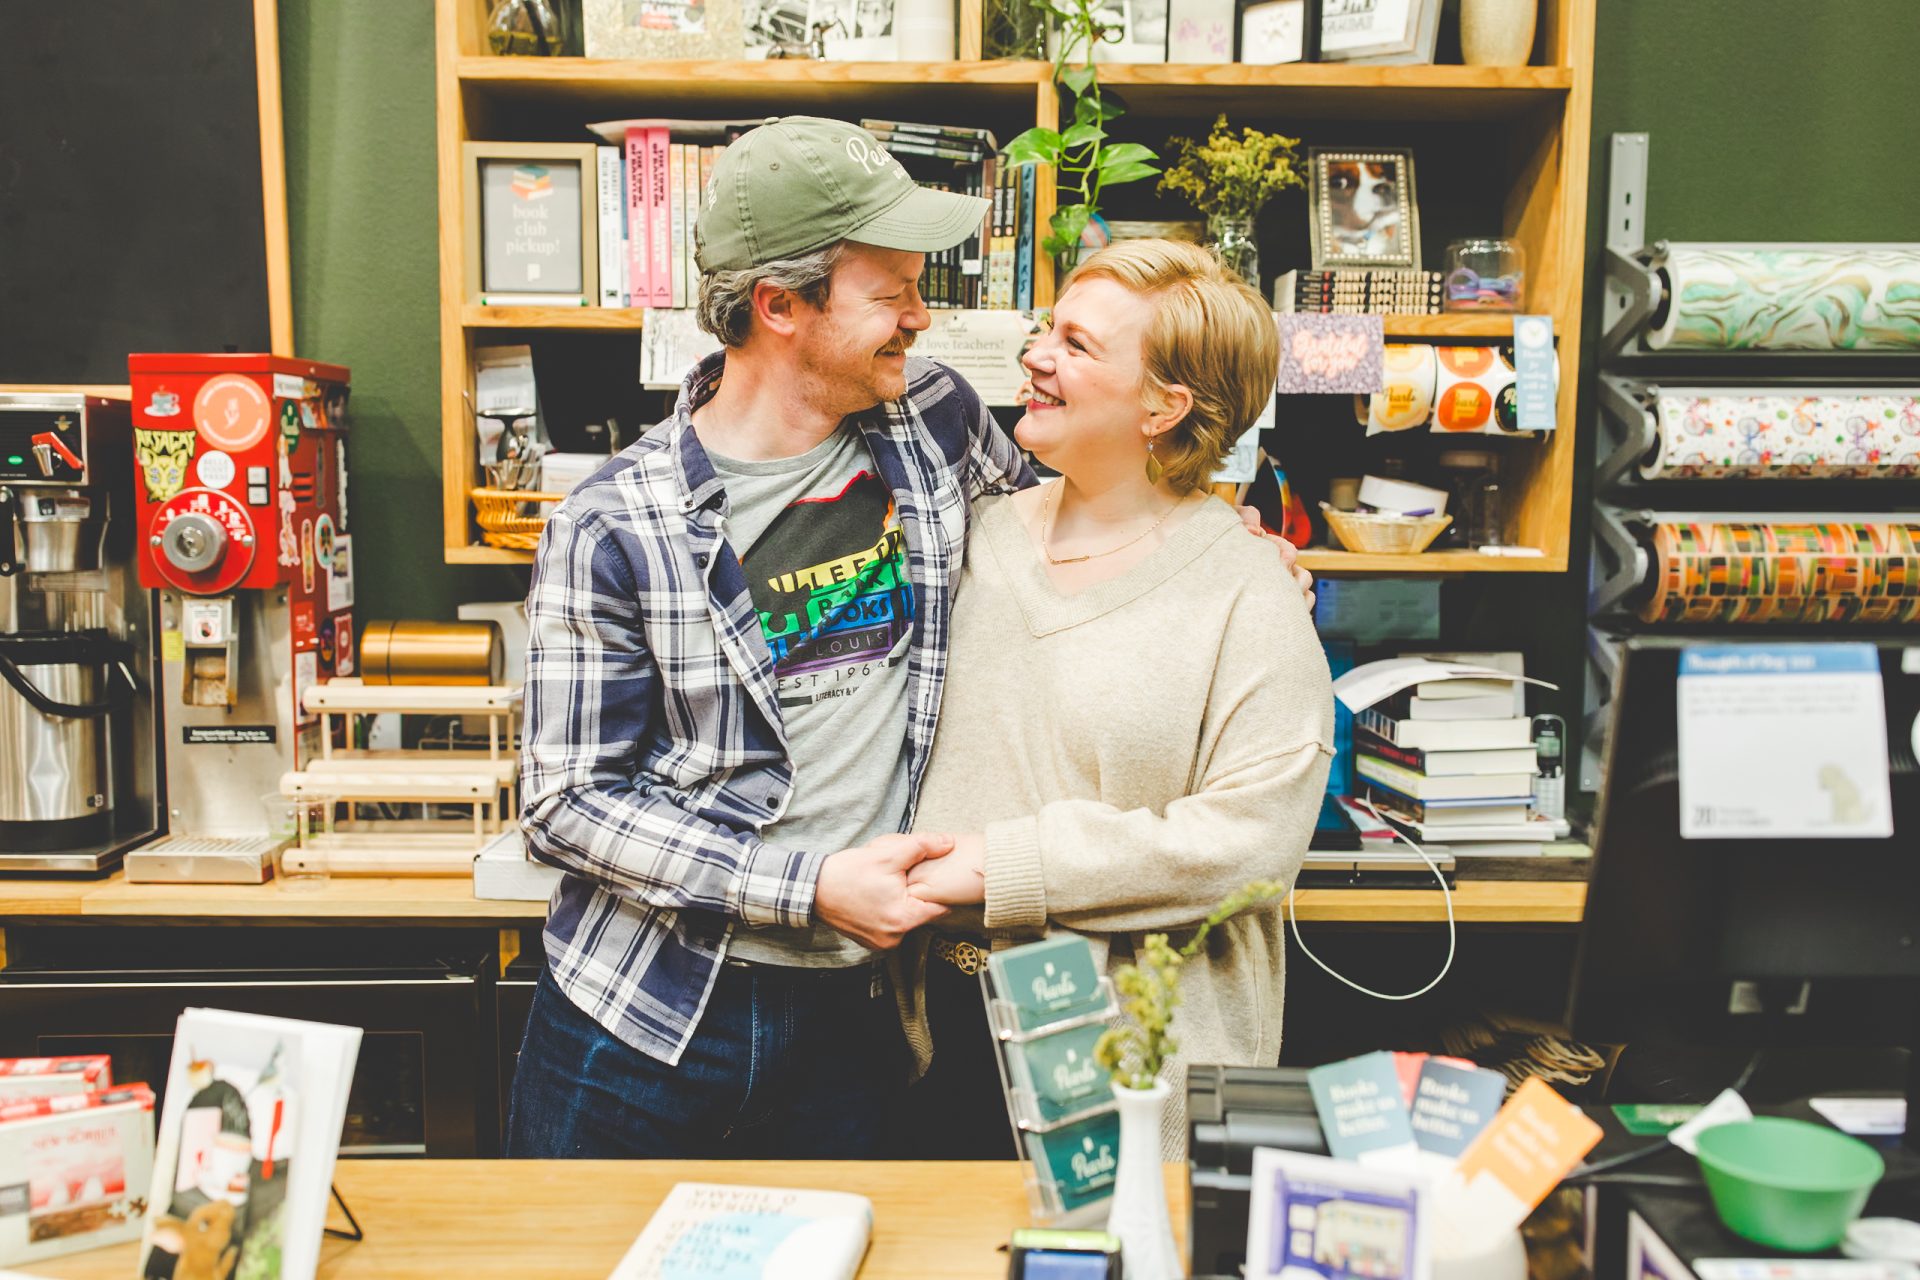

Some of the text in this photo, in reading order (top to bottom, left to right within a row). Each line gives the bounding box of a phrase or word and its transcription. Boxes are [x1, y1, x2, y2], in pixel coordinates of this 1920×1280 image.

[513, 203, 548, 219] book
[515, 221, 546, 236] club
[506, 238, 560, 256] pickup!
[927, 339, 950, 350] love
[953, 339, 1005, 350] teachers!
[815, 687, 852, 702] LITERACY &
